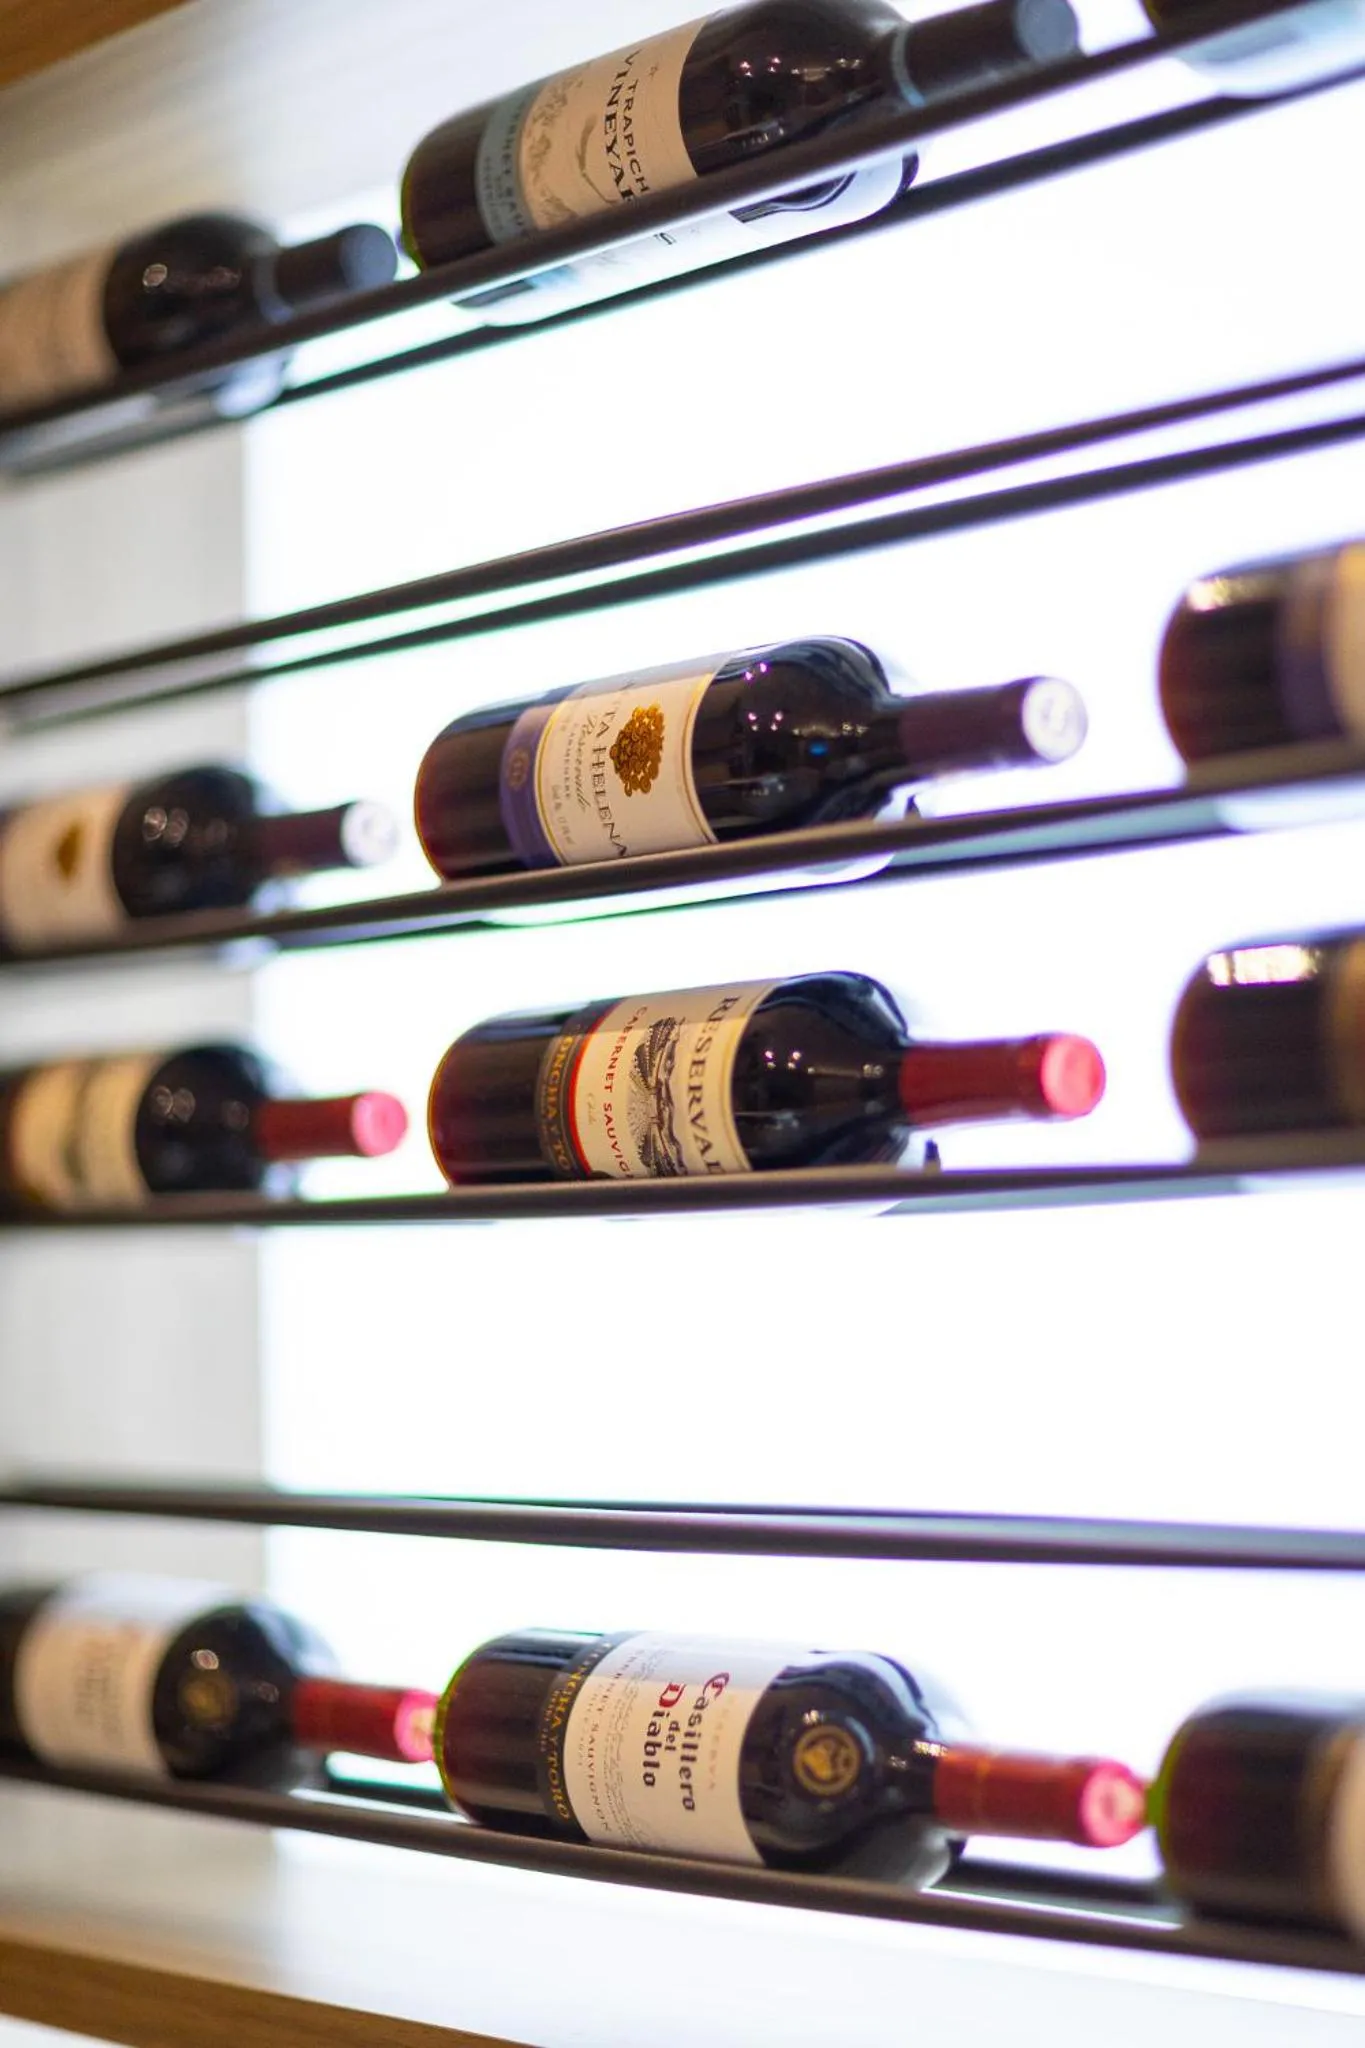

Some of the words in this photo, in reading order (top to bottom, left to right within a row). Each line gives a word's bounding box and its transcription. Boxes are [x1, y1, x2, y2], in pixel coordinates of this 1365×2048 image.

[623, 78, 650, 194] TRAPICH
[591, 746, 628, 857] HELENA
[546, 1024, 579, 1119] ONCHA
[604, 1006, 648, 1093] CABERNET
[603, 1103, 634, 1178] SAUVIG
[643, 1682, 687, 1788] Diablo
[664, 1720, 681, 1752] del
[679, 1672, 730, 1812] Casillero
